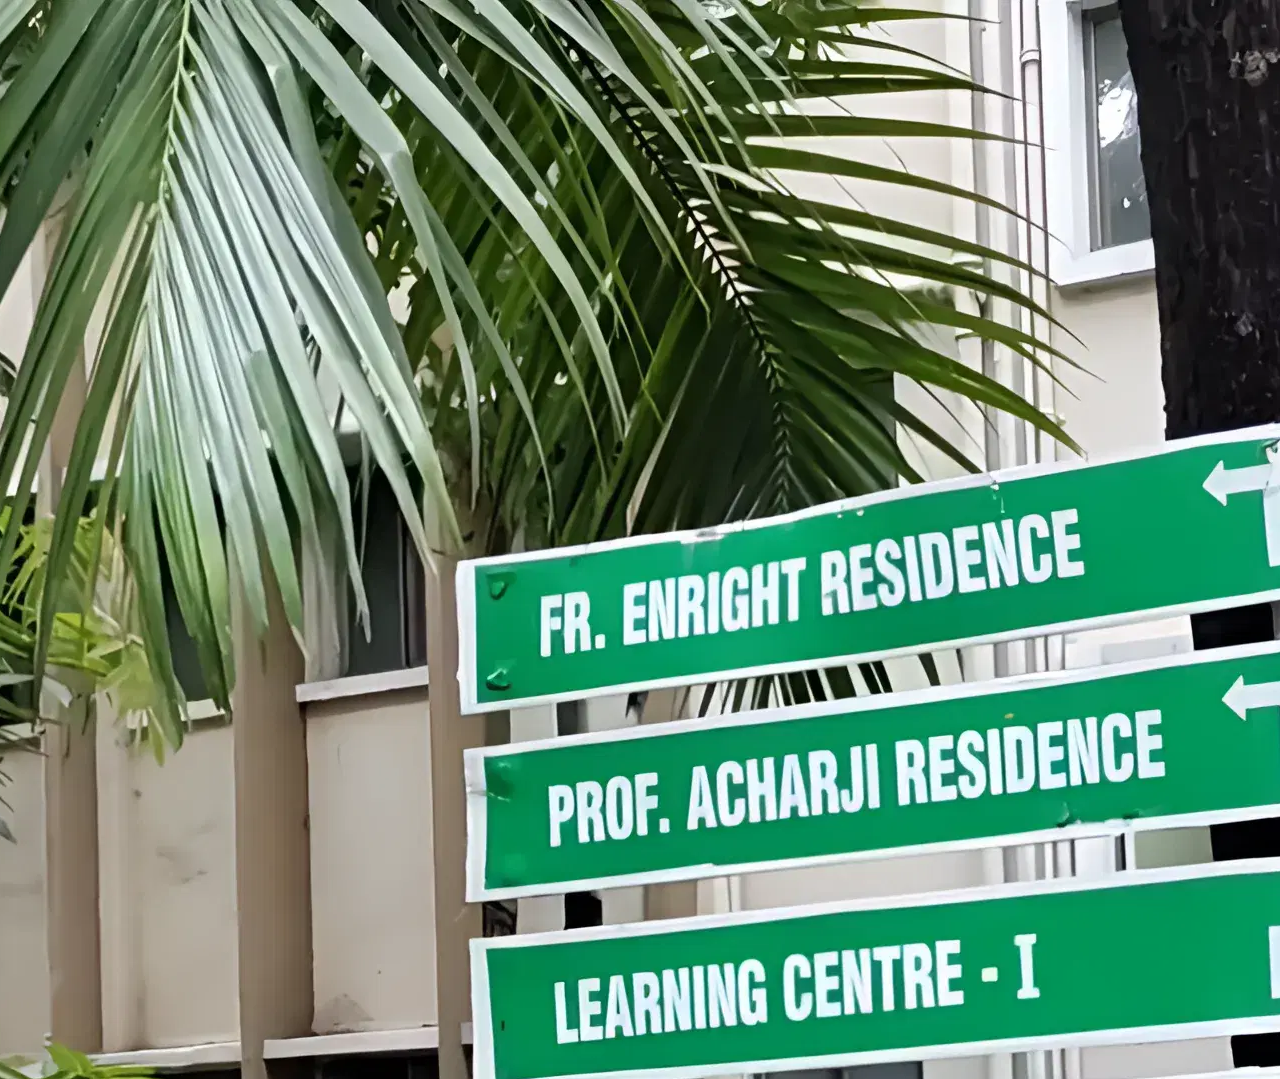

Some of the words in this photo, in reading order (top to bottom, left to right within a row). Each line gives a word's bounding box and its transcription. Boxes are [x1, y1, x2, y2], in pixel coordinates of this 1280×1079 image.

[541, 592, 606, 658] FR.
[623, 557, 807, 646] ENRIGHT
[820, 509, 1085, 616] RESIDENCE
[548, 773, 670, 848] PROF.
[687, 743, 881, 831] ACHARJI
[895, 710, 1166, 806] RESIDENCE
[554, 959, 768, 1045] LEARNING
[783, 940, 965, 1021] CENTRE
[981, 967, 998, 983] -
[1014, 933, 1040, 1000] I
